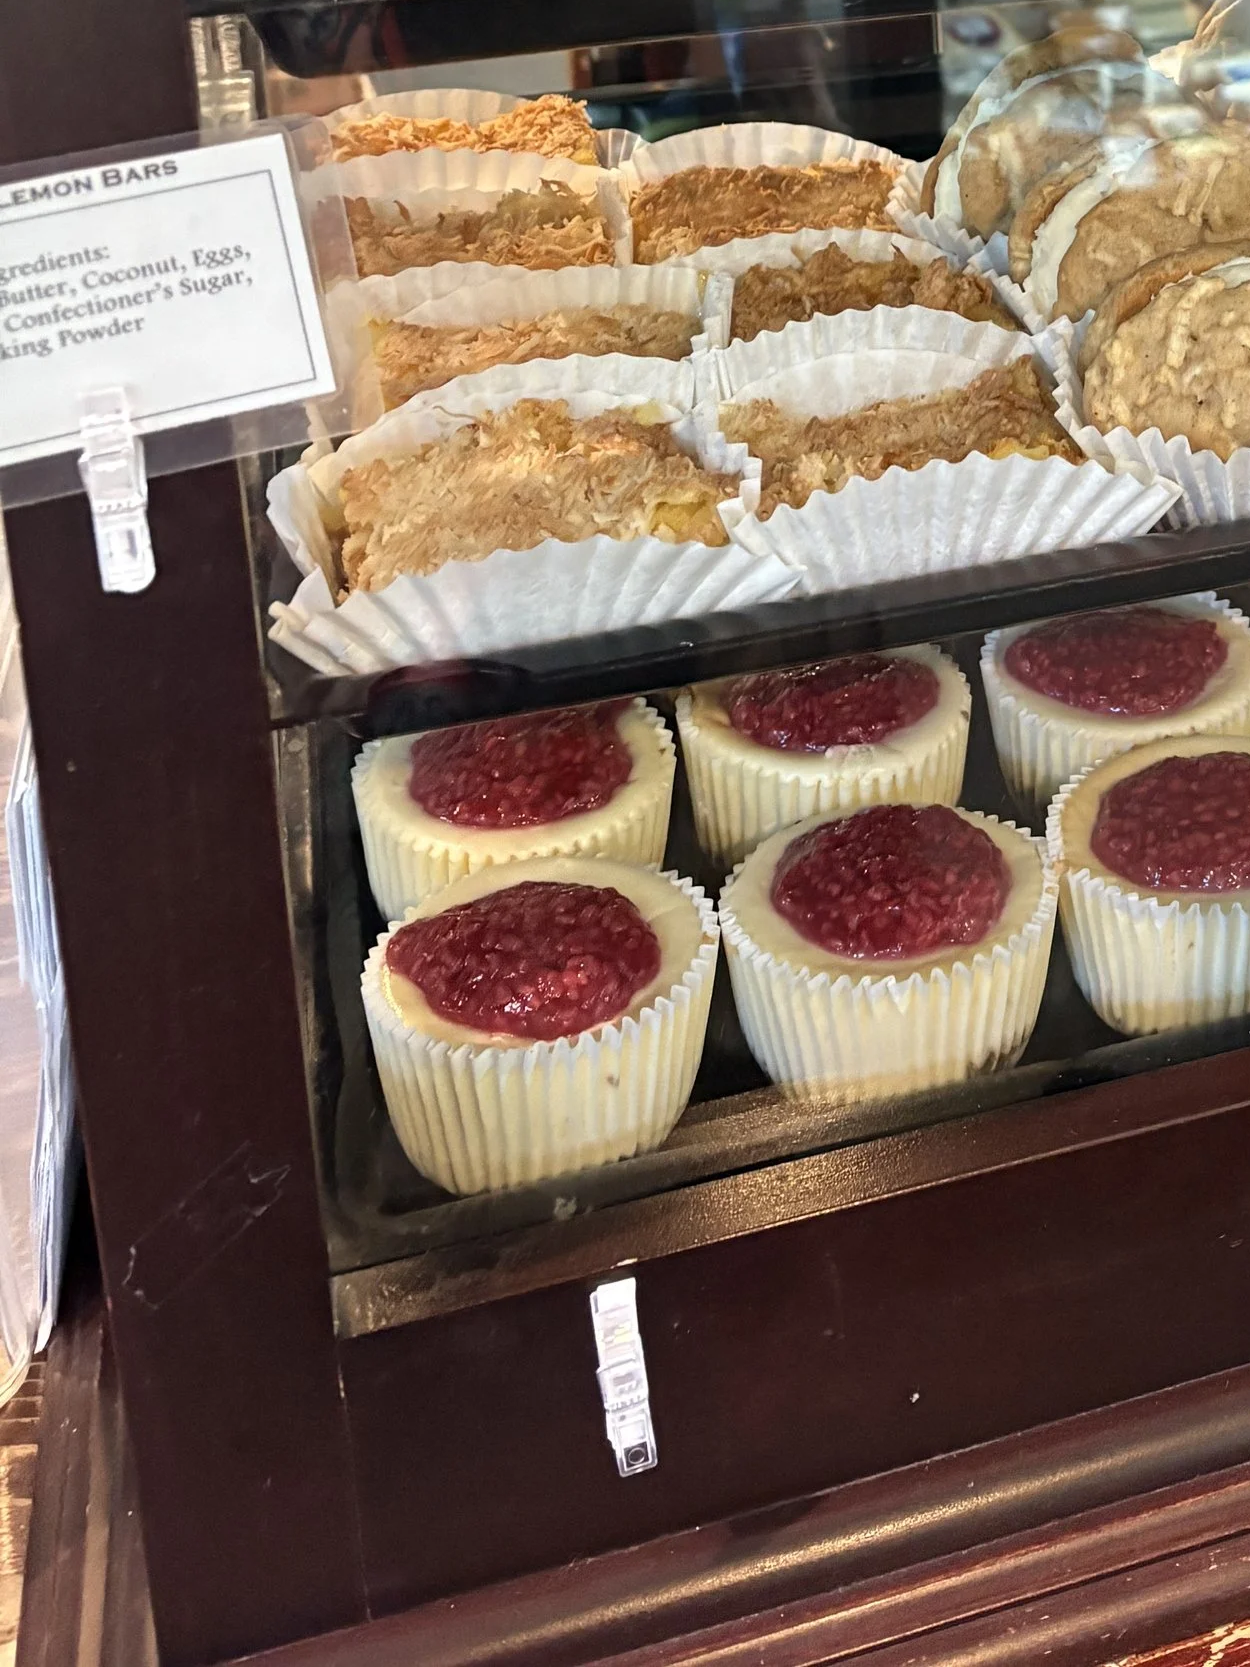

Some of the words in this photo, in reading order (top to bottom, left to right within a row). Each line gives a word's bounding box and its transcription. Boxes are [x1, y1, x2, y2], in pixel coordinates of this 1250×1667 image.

[101, 160, 179, 188] BARS
[82, 257, 187, 289] Coconut,
[192, 243, 251, 269] Eggs,
[179, 267, 253, 297] Sugar,
[58, 316, 145, 348] Powder
